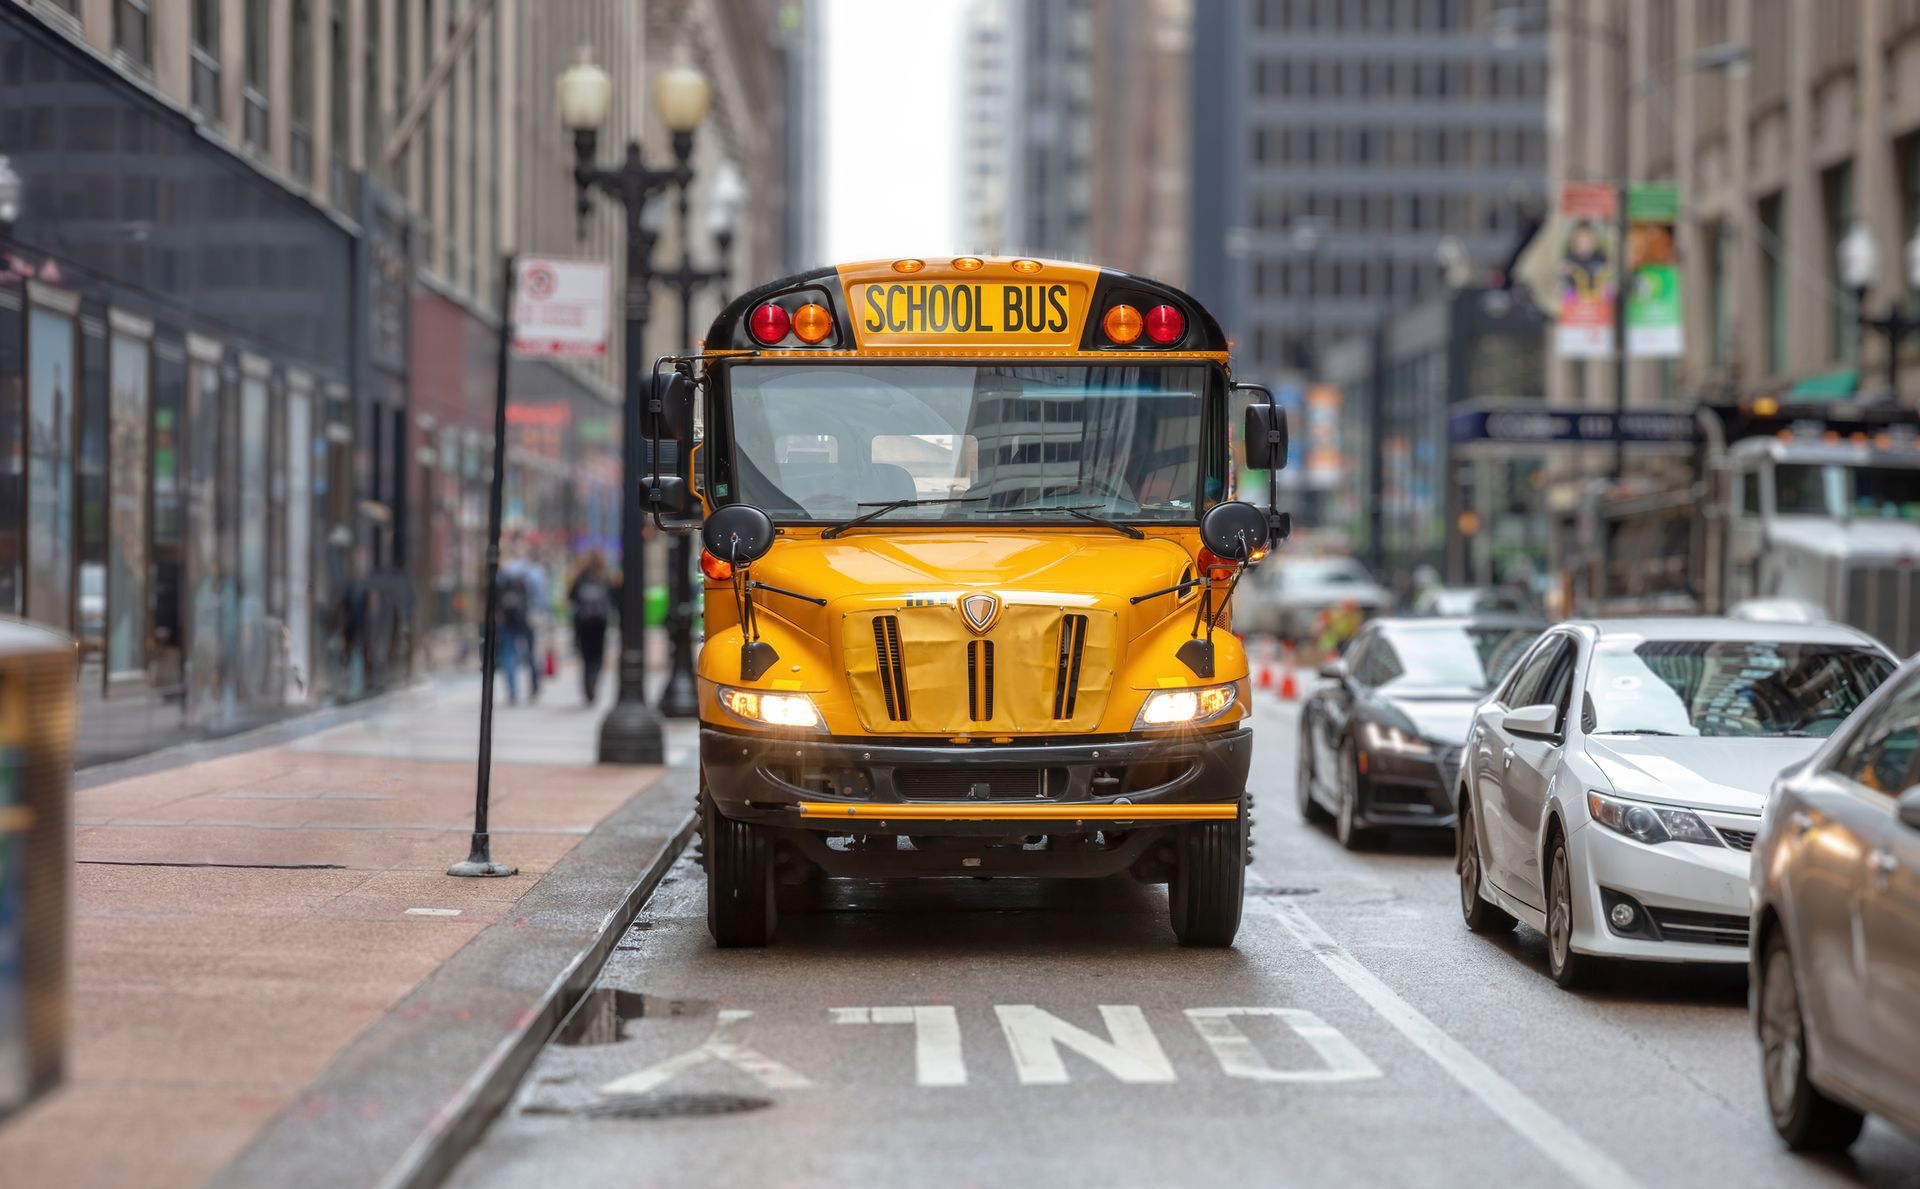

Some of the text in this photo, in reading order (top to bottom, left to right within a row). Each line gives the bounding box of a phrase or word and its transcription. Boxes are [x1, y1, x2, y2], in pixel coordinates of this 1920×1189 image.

[866, 284, 1068, 333] SCHOOL BUS
[602, 1004, 1383, 1091] ONLY
